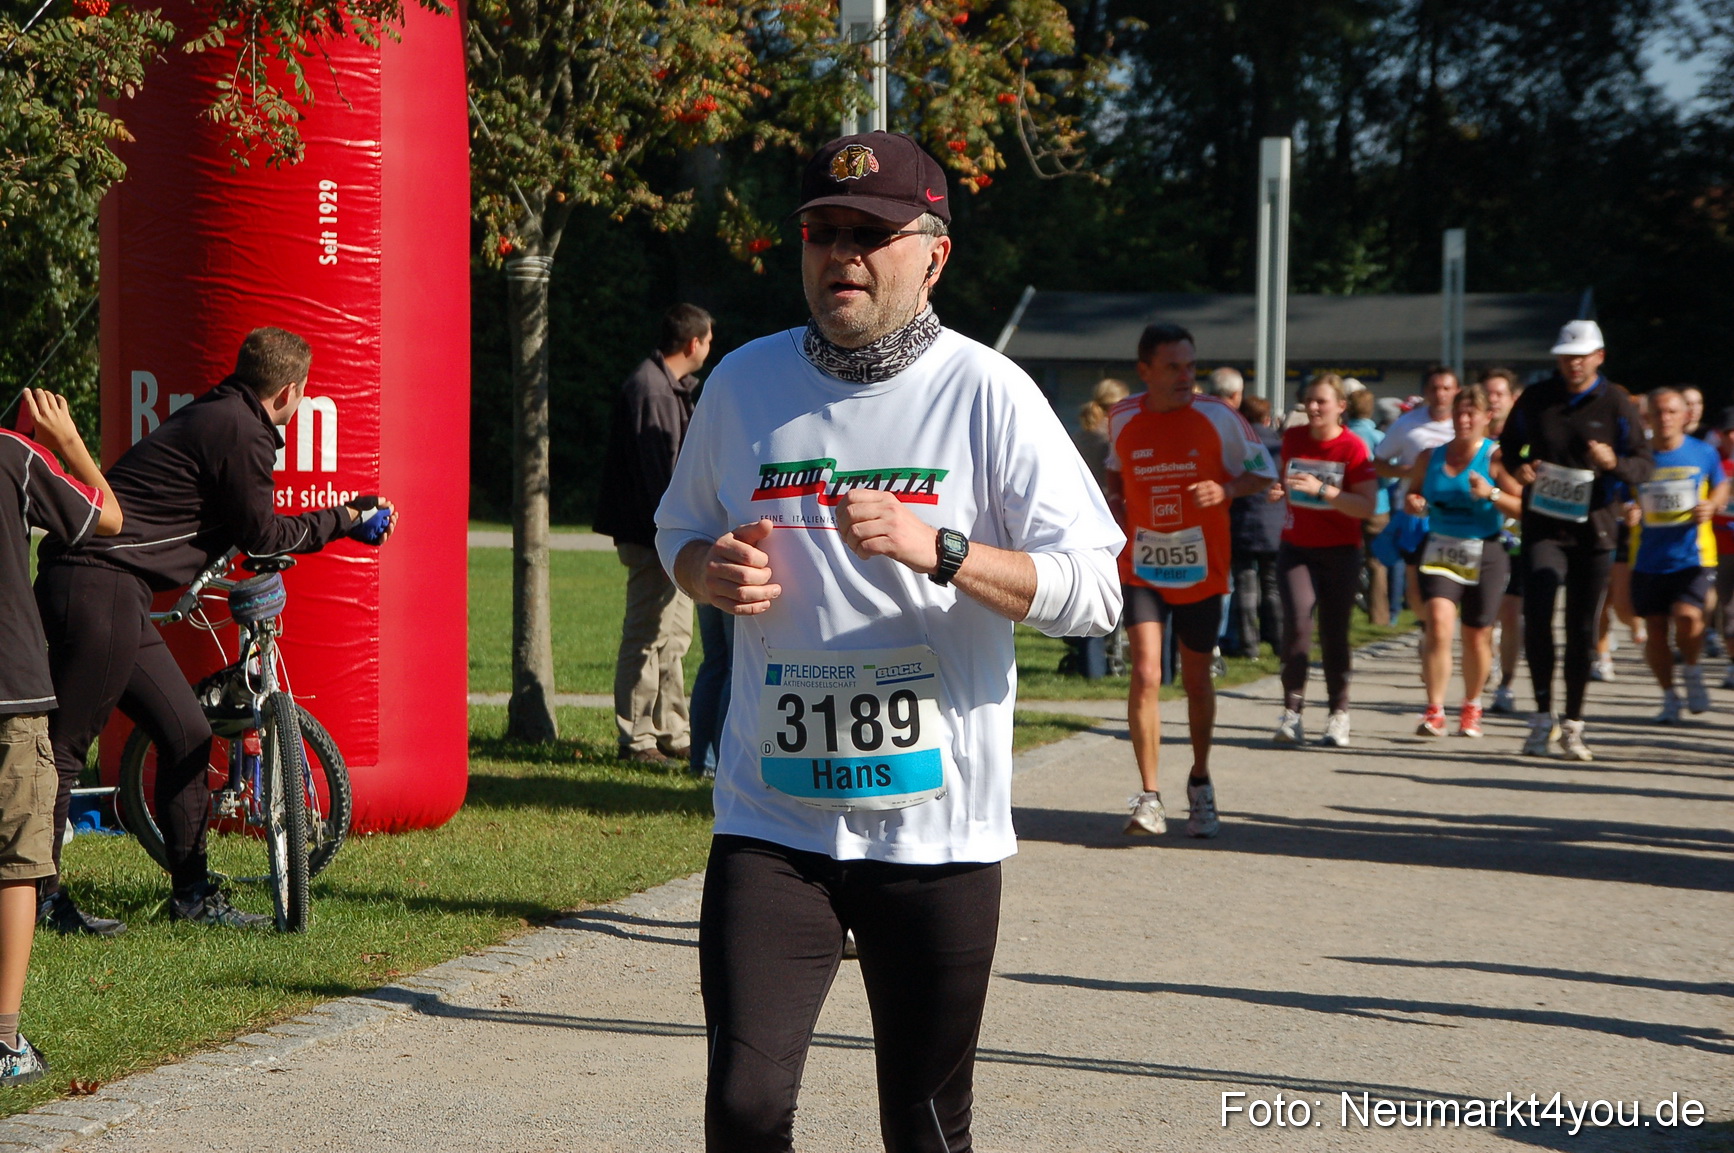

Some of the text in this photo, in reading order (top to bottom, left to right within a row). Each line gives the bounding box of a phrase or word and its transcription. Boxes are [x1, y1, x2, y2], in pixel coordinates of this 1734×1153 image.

[318, 179, 338, 265] Seit 1929
[1134, 462, 1197, 475] SportScheck
[272, 486, 294, 508] st
[1155, 503, 1178, 517] GfK
[1141, 545, 1199, 565] 2055
[1154, 568, 1188, 579] Peter
[784, 664, 856, 679] PFLEIDERER
[876, 662, 922, 679] BOCK
[783, 680, 857, 689] AKTIENGESELLSCHAFT
[776, 689, 920, 753] 3189
[812, 759, 892, 790] Hans
